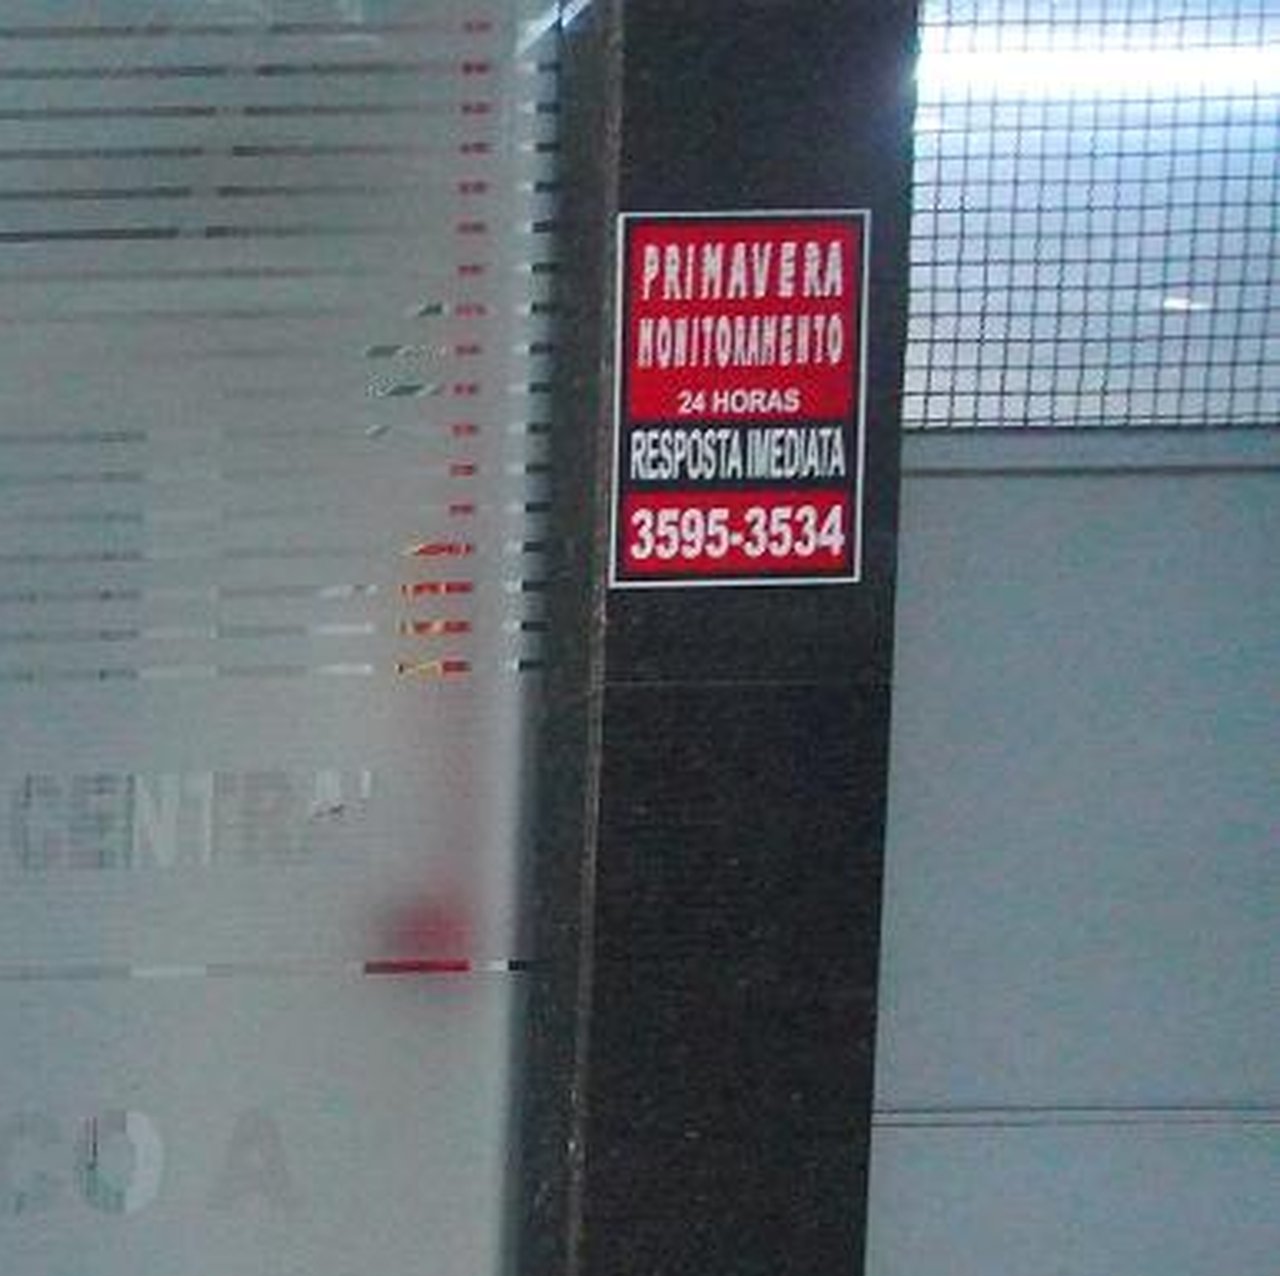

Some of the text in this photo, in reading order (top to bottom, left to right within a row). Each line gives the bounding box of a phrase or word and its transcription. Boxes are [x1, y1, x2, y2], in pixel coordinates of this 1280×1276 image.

[642, 240, 843, 301] PRIMAVERA
[637, 313, 843, 369] MONITORAMENTO
[677, 388, 802, 415] 24 HORAS
[629, 426, 846, 480] RESPOSTA IMEDIATA
[629, 504, 846, 560] 3595-3534
